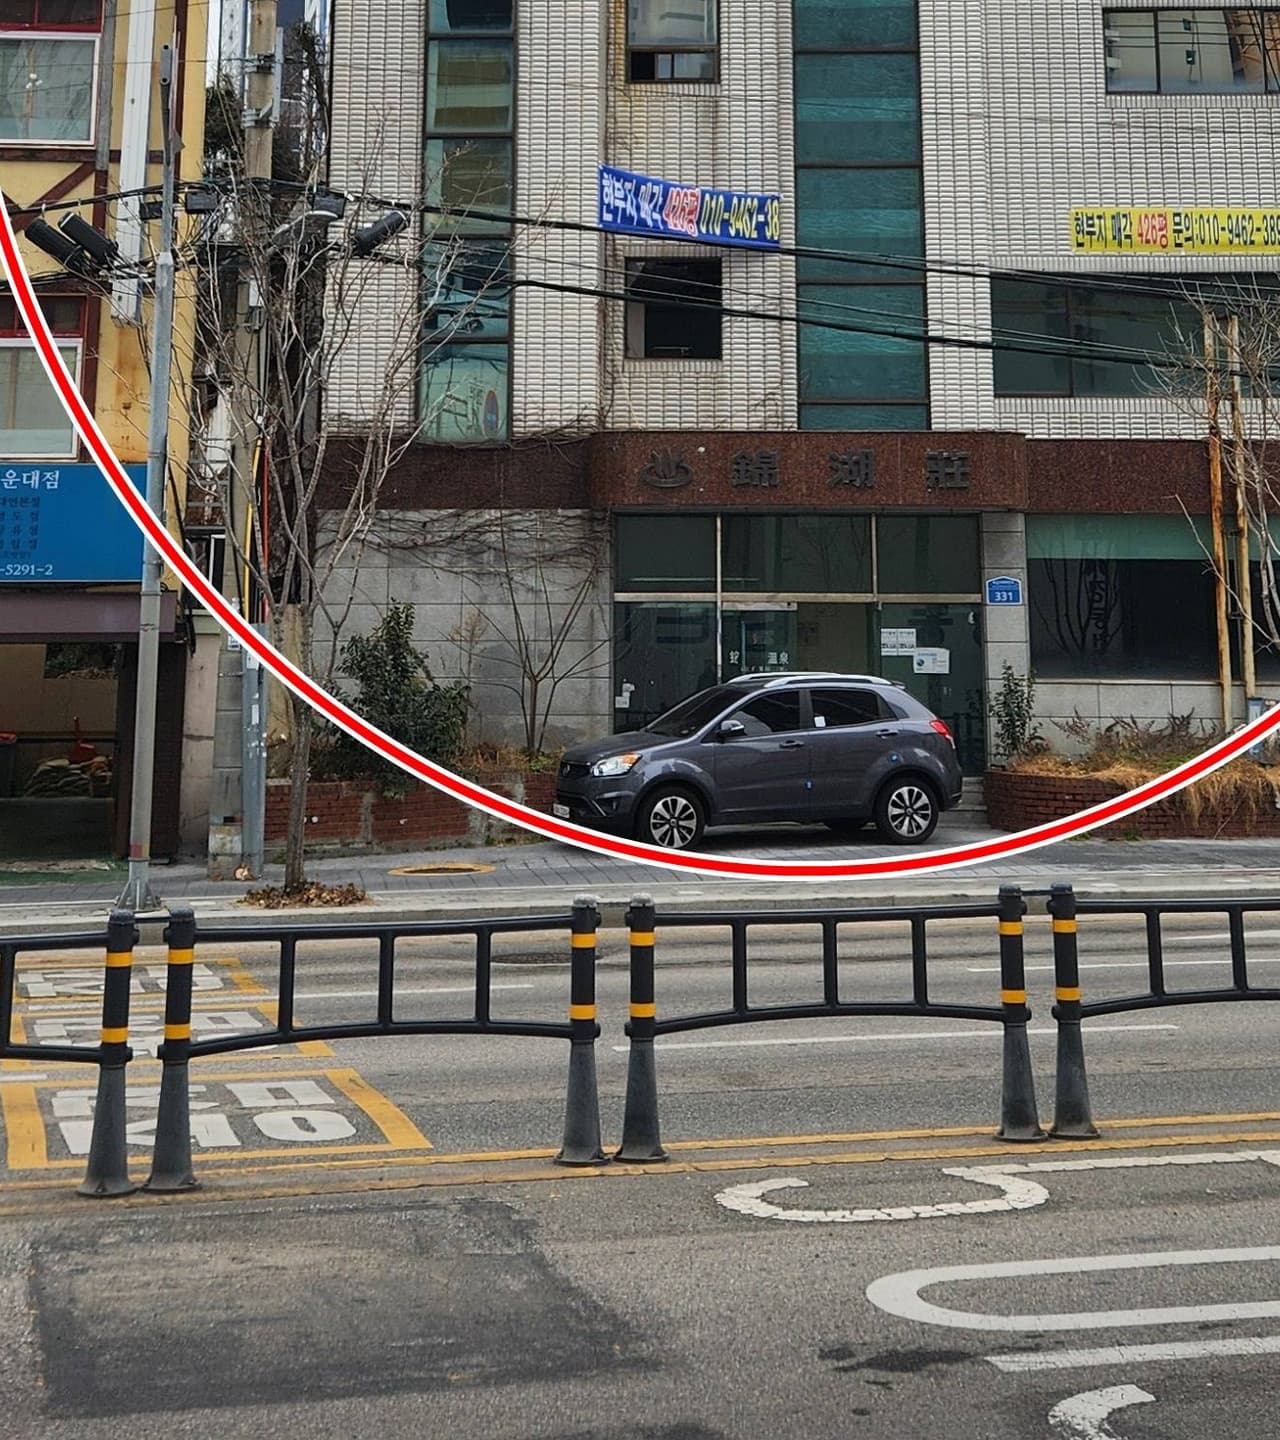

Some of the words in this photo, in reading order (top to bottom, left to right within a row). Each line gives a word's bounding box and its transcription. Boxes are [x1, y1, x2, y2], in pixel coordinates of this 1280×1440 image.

[1074, 212, 1107, 249] 현부지
[1111, 212, 1133, 249] 매각
[1137, 213, 1168, 249] 426평
[994, 591, 1013, 601] 331
